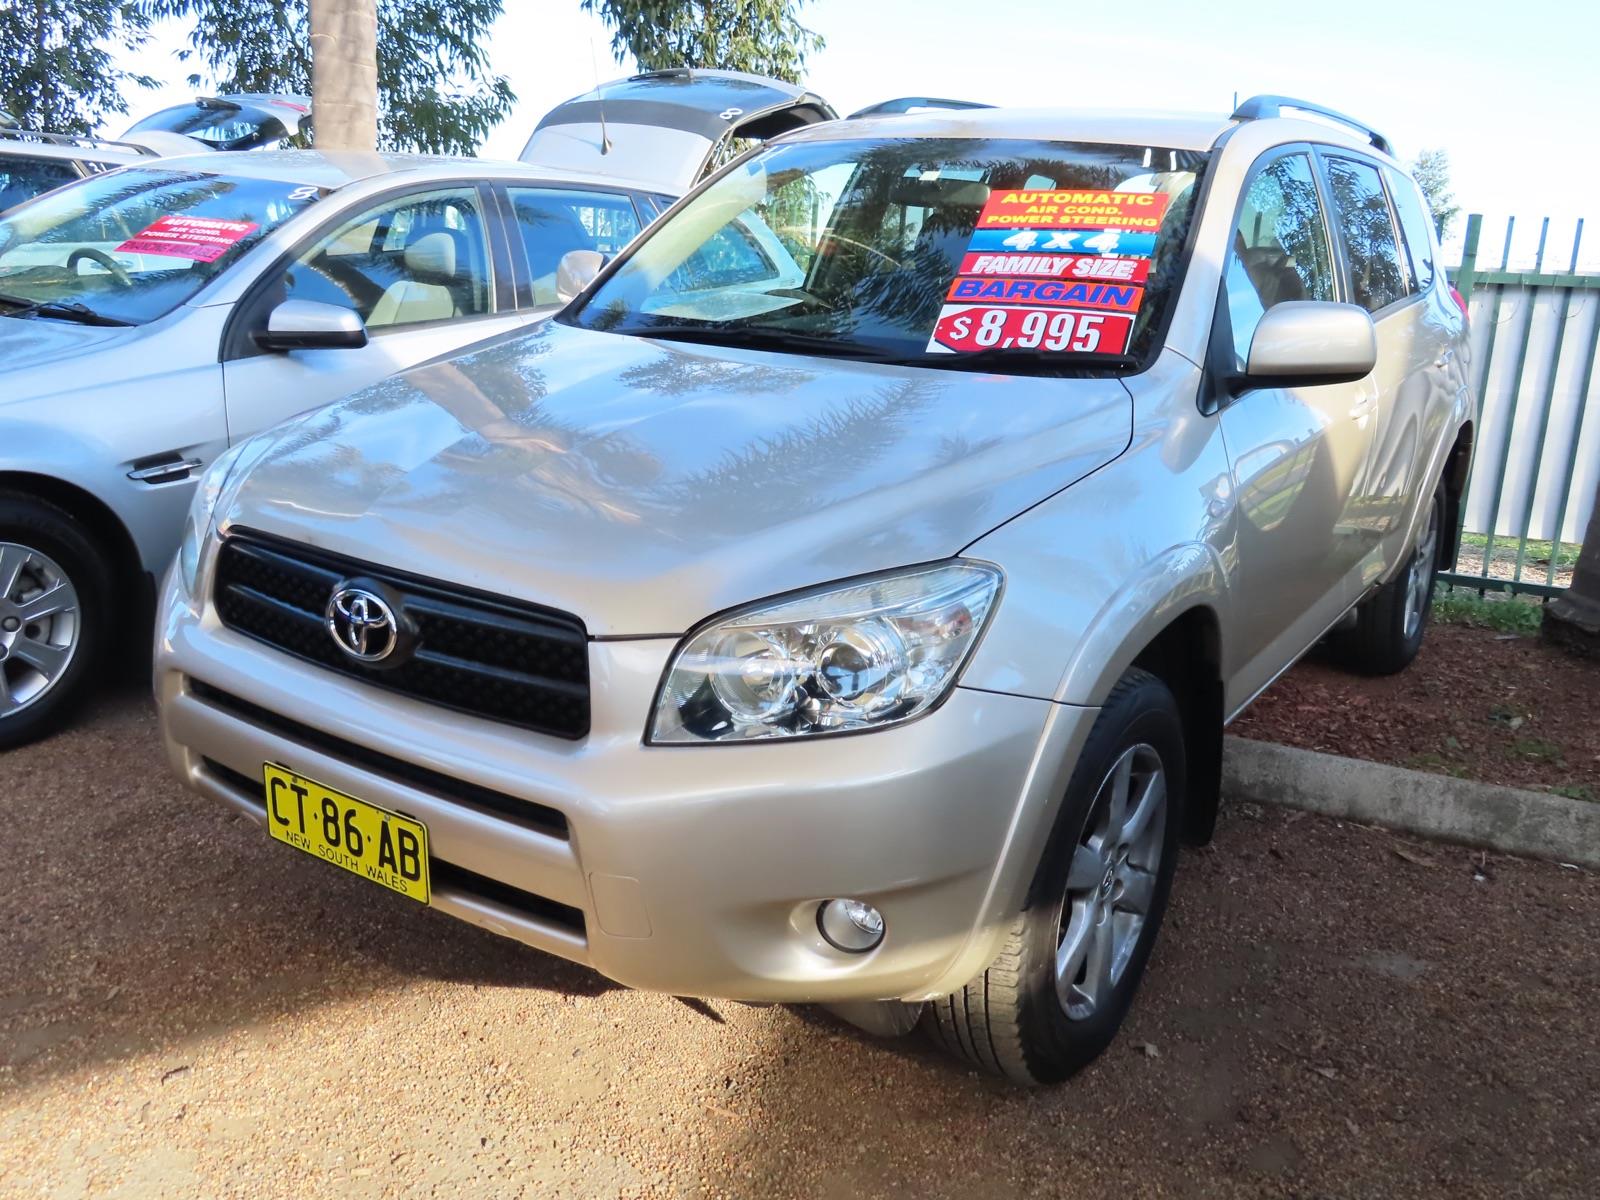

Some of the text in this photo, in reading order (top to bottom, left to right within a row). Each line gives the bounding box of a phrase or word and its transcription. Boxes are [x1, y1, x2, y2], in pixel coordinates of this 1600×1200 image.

[287, 186, 319, 200] 8
[1000, 192, 1155, 206] AUTOMATIC
[1025, 206, 1123, 215] AIR COND.
[161, 217, 249, 232] AUTOMATIC
[986, 215, 1158, 227] POWER STEERING
[141, 231, 235, 244] POWER STEERING
[970, 255, 1137, 280] FAMILY SIZE
[953, 280, 1136, 306] BARGAIN
[286, 831, 407, 891] NEW SOUTH WALES
